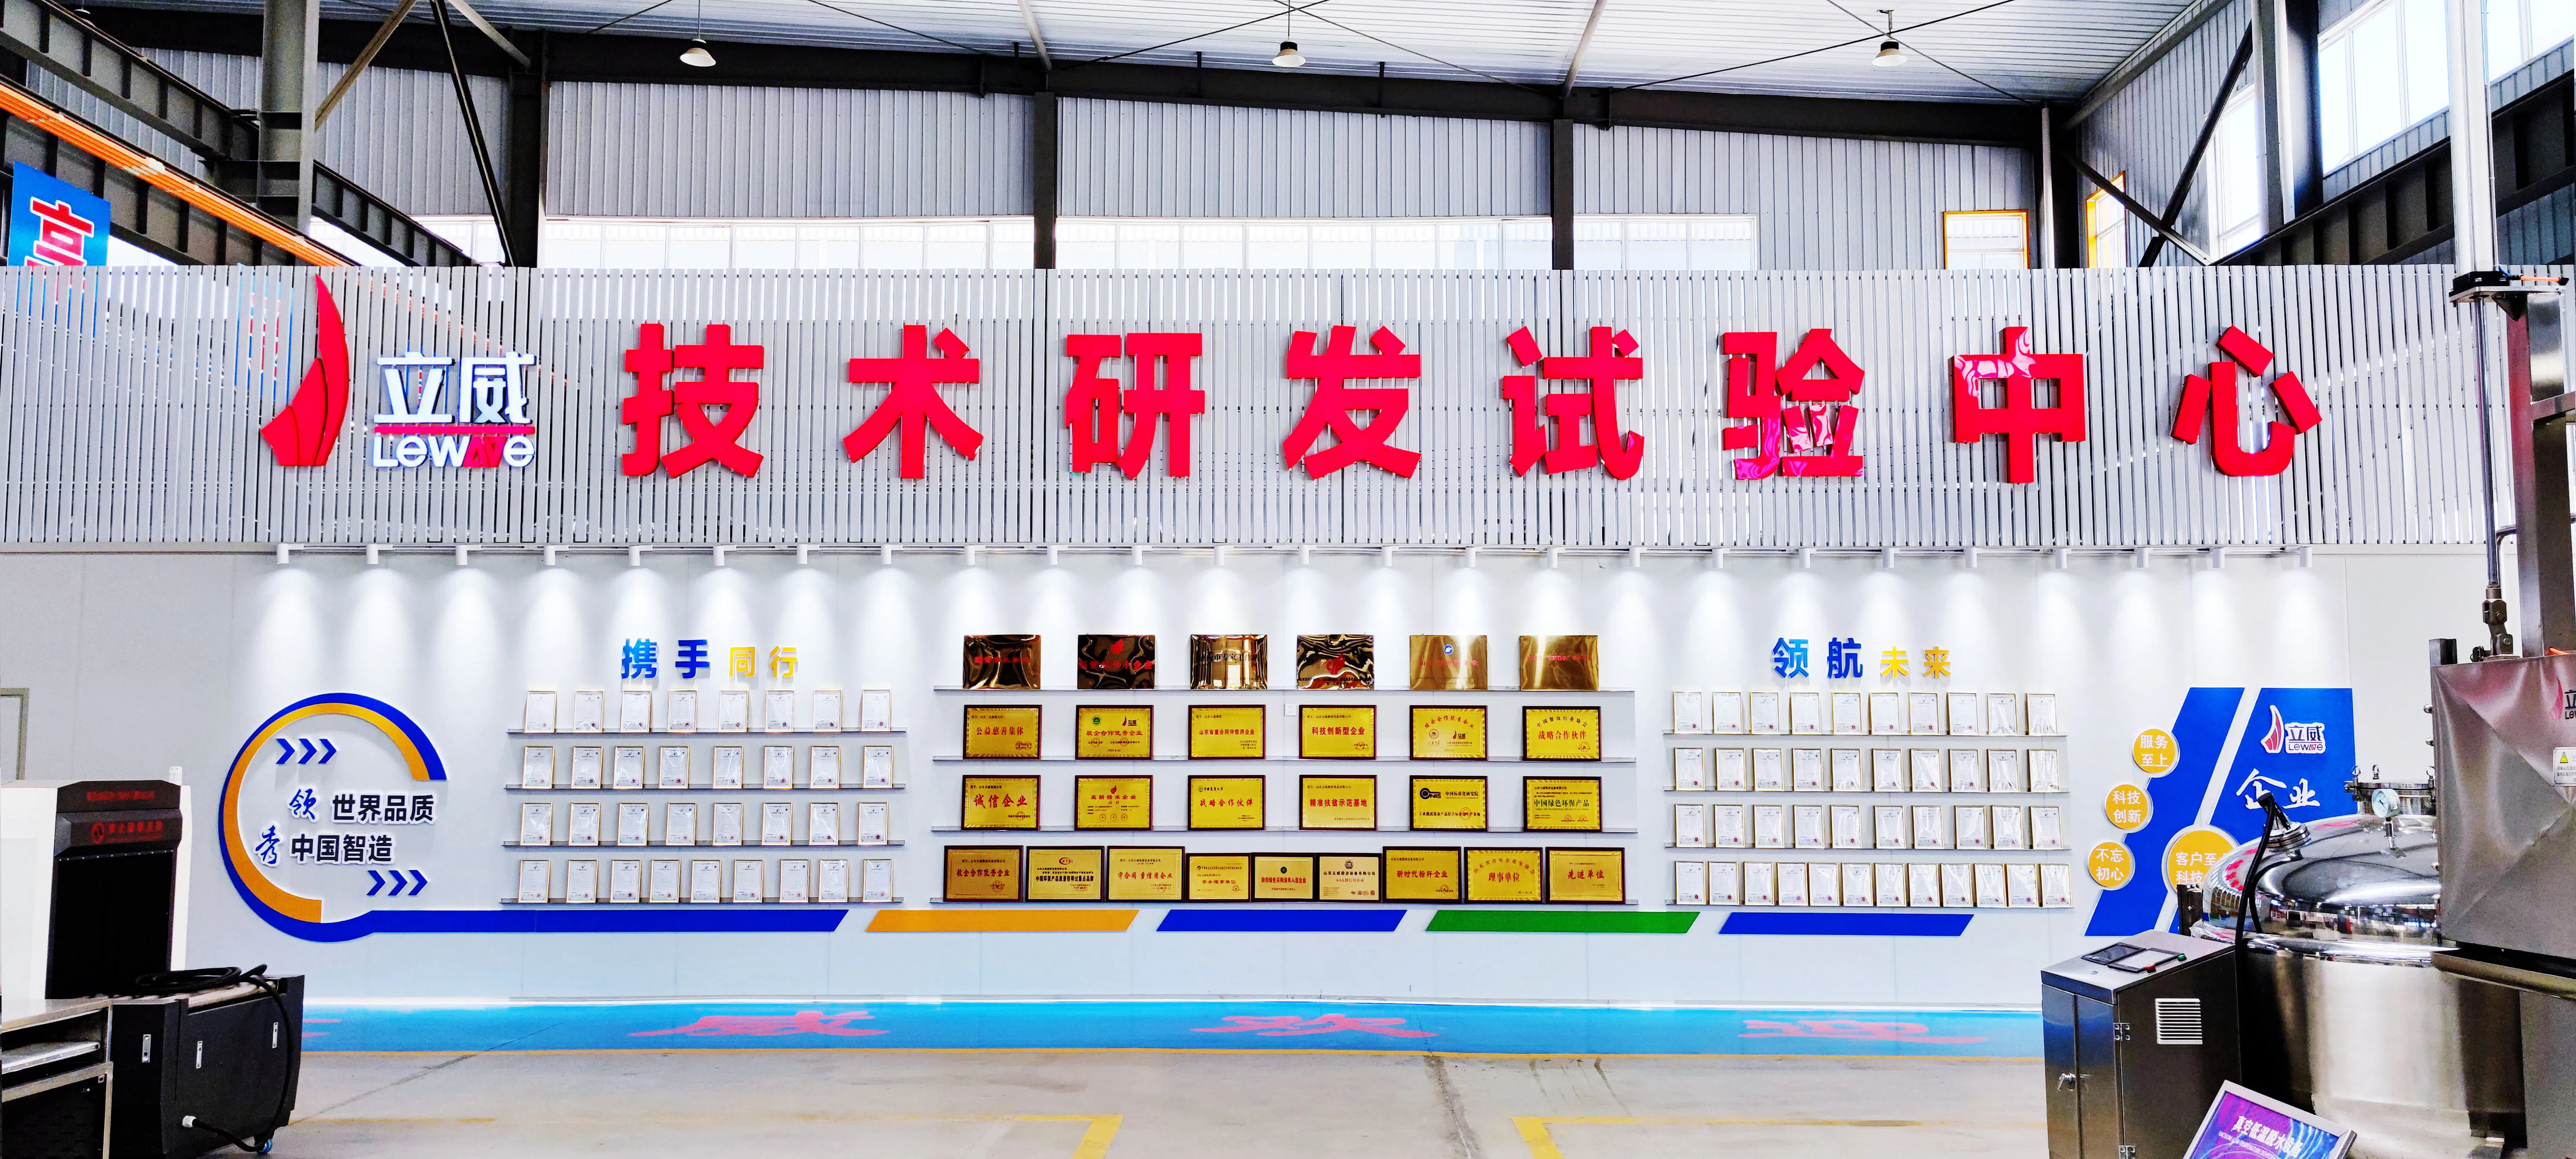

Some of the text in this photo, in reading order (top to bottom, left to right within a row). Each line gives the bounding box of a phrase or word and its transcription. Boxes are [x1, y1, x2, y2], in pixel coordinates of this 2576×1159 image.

[373, 352, 535, 423] 立威
[621, 323, 2322, 485] 技术研发试验中心
[621, 638, 798, 679] 携手同行
[1772, 637, 1950, 679] 领航未来
[976, 726, 1023, 735] 公益慈善集体
[1312, 727, 1365, 735] 科技创新型企业
[1539, 730, 1586, 740] 战略合作伙伴
[2288, 726, 2322, 741] 立威
[2140, 735, 2168, 749] 服务
[2141, 754, 2169, 767] 至上
[974, 794, 1028, 809] 诚信企业
[1200, 798, 1253, 807] 战略合作伙伴
[1310, 799, 1367, 807] 精准扶贫示范基地
[2113, 791, 2140, 804] 科技
[289, 788, 434, 822] 领 世界品质
[2113, 809, 2141, 824] 创新
[255, 825, 393, 864] 秀 中国智造
[2096, 848, 2123, 863] 不忘
[956, 869, 1010, 877] 校企合作优秀企业
[1489, 872, 1519, 882] 理事单位
[1568, 869, 1604, 879] 先进单位
[2096, 867, 2124, 881] 初心
[2231, 1115, 2304, 1158] 真空低温脱水设备
